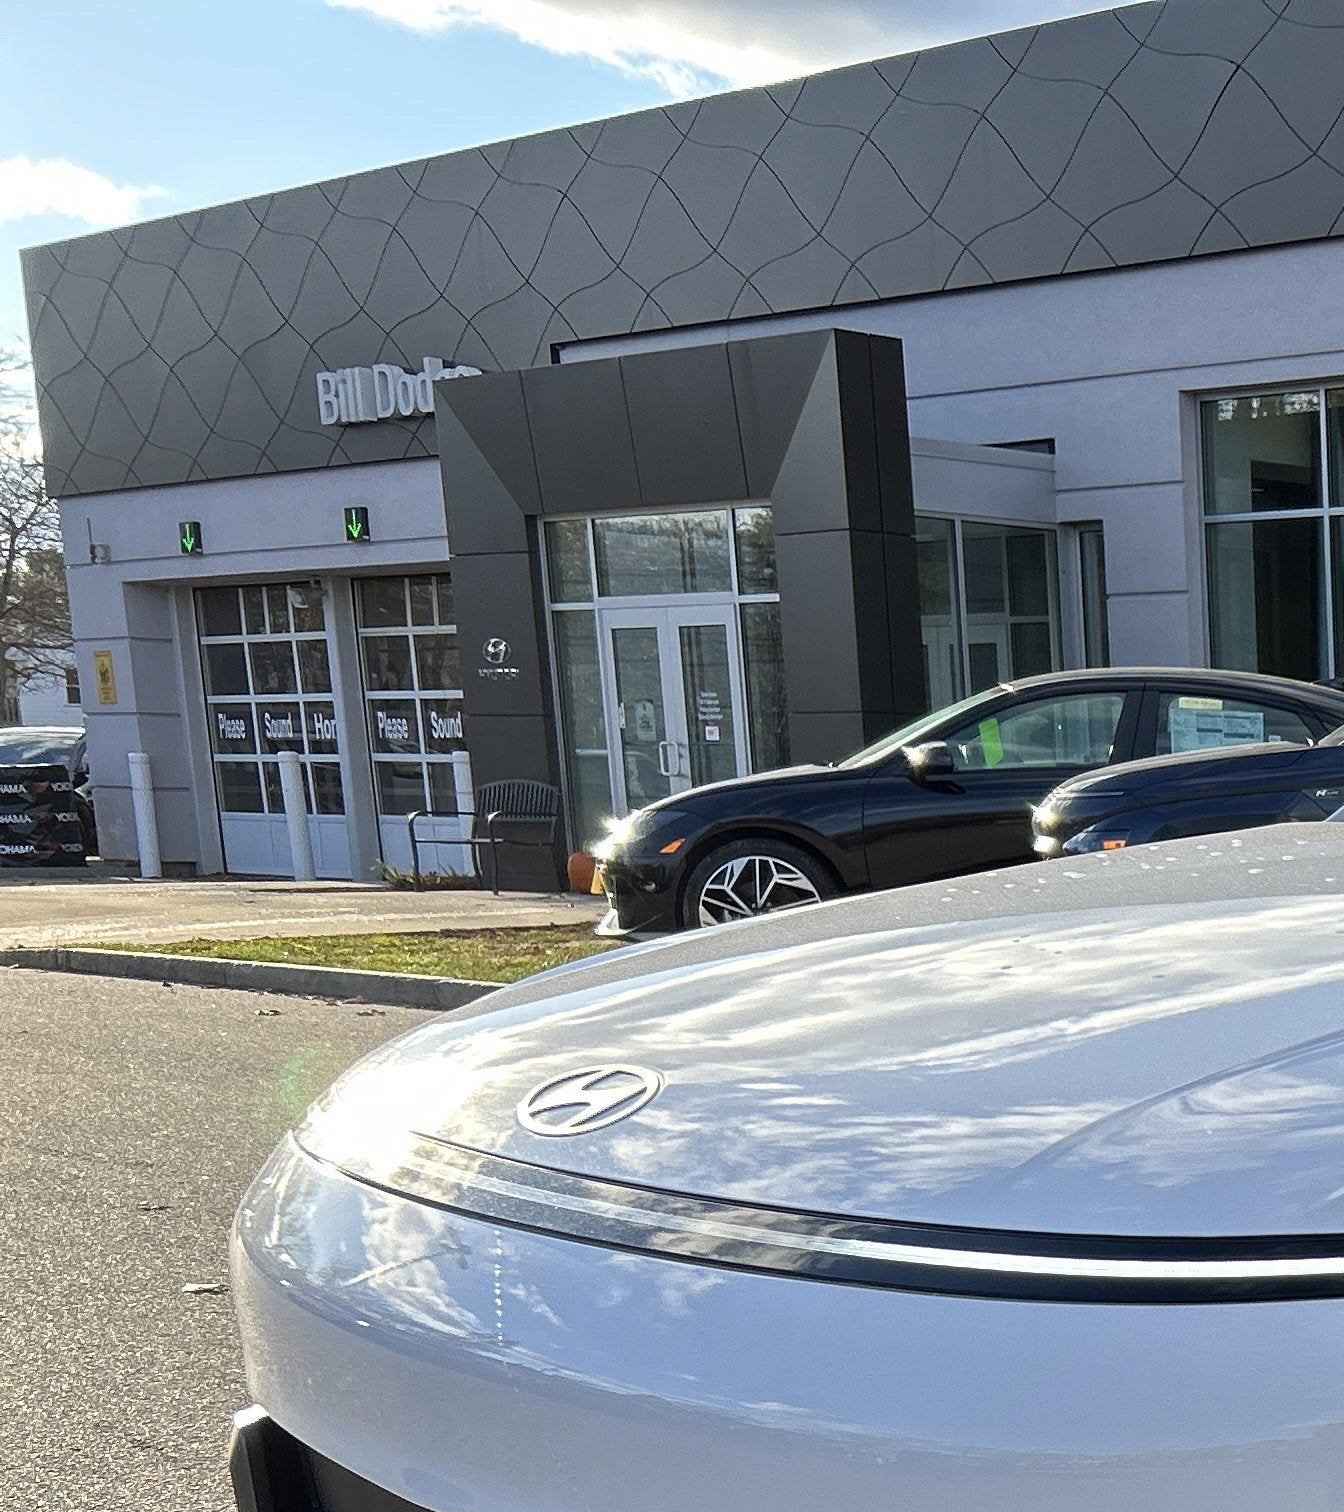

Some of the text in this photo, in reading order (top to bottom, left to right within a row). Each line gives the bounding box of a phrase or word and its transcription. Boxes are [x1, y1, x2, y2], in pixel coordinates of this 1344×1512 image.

[316, 356, 483, 425] Bill Dod
[218, 712, 337, 740] Please Sound Hor
[377, 711, 463, 739] Please Sound
